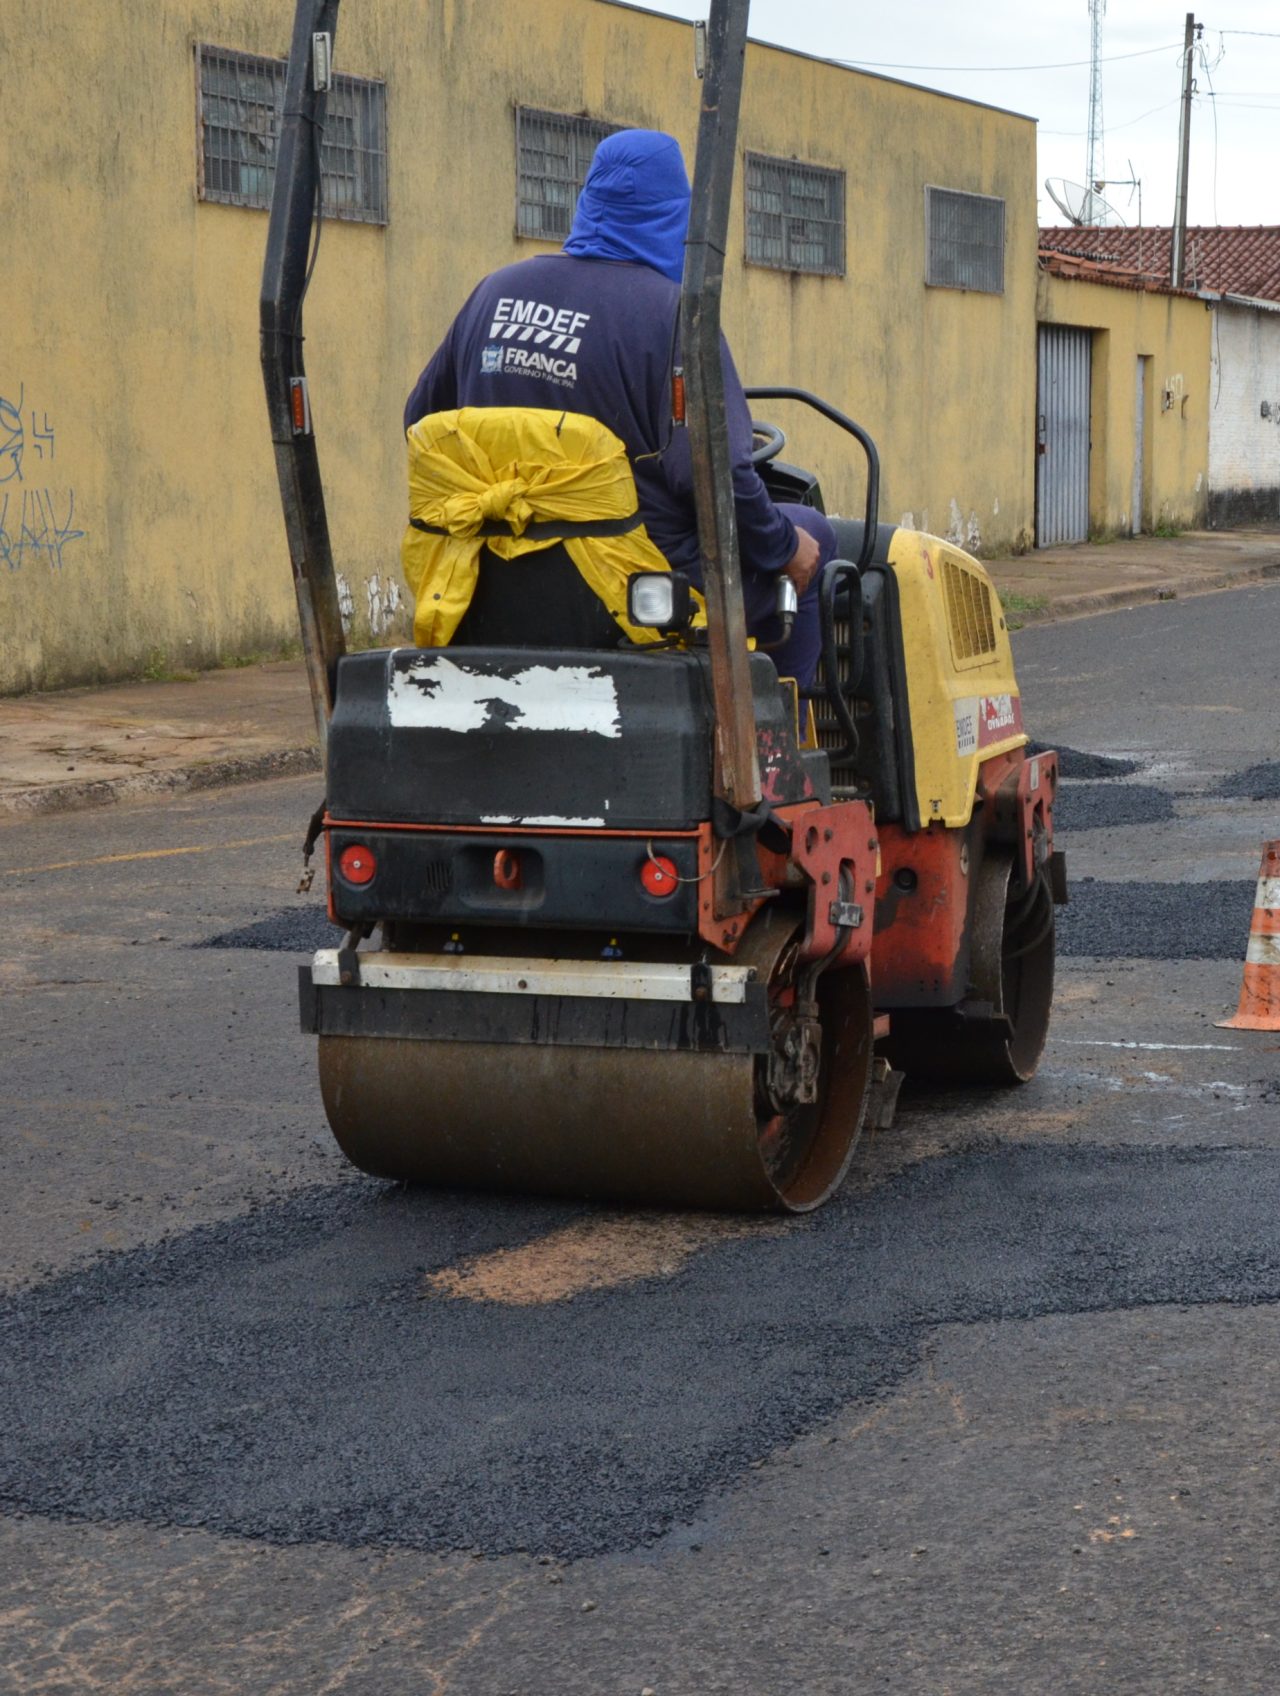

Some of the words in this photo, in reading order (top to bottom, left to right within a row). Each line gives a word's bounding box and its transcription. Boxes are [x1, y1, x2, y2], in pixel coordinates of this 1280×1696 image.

[494, 298, 591, 335] EMDEF
[504, 365, 541, 378] GOVERNO
[505, 347, 577, 380] FRANCA
